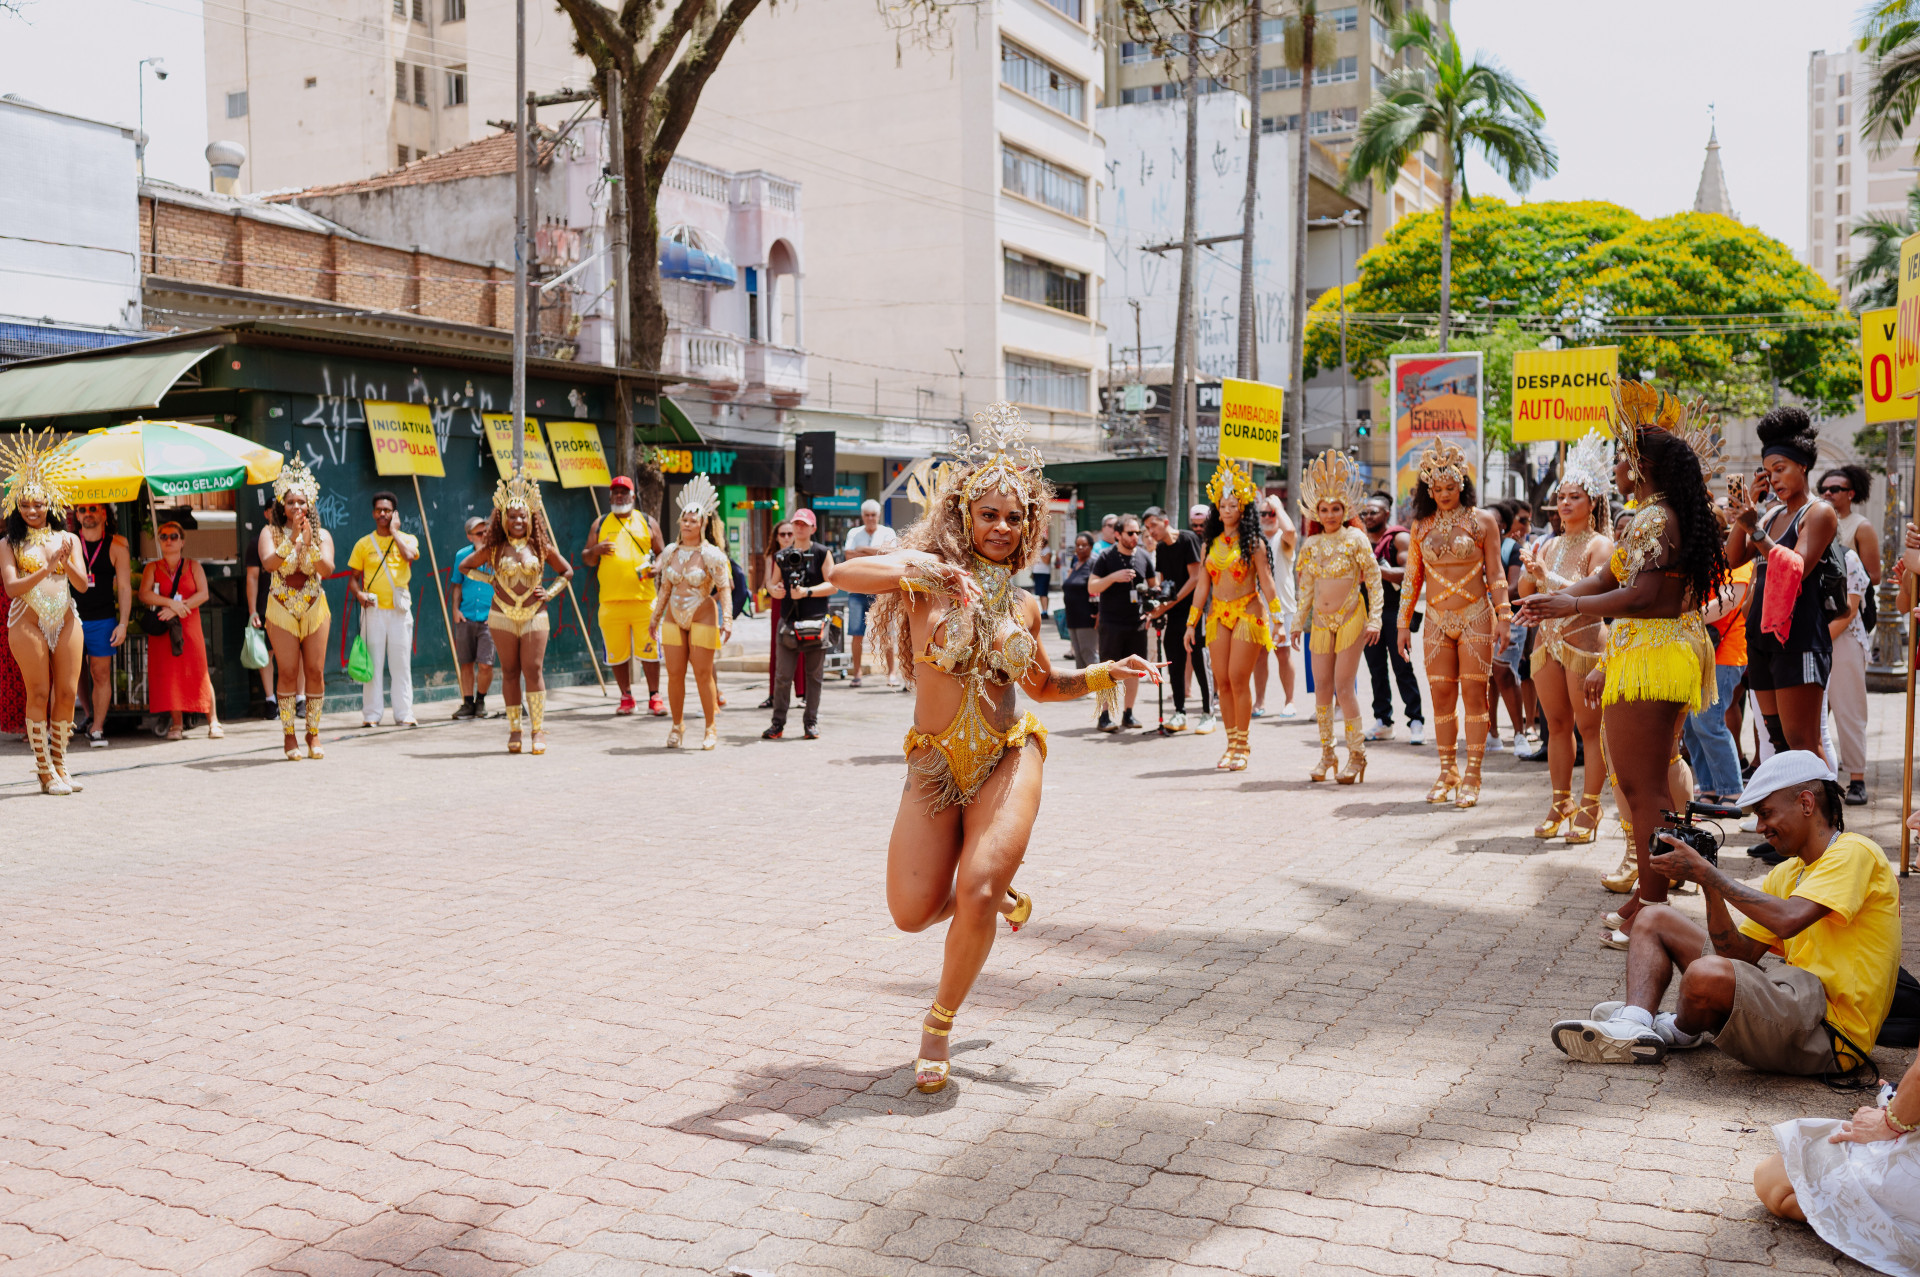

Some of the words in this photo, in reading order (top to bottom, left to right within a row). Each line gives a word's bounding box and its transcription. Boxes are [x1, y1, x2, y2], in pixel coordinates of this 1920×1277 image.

[1907, 252, 1920, 282] VE
[1899, 295, 1920, 370] OU
[1517, 372, 1609, 389] DESPACHO
[1225, 402, 1279, 425] SAMBACURA
[1518, 398, 1606, 422] AUTONOMIA
[373, 419, 432, 435] INICIATIVA
[1224, 423, 1278, 443] CURADOR
[376, 438, 437, 457] POPULAR
[555, 436, 601, 453] PRÓPRIO
[87, 487, 128, 499] GELADO
[162, 480, 190, 494] COCO
[192, 475, 234, 491] GELADO
